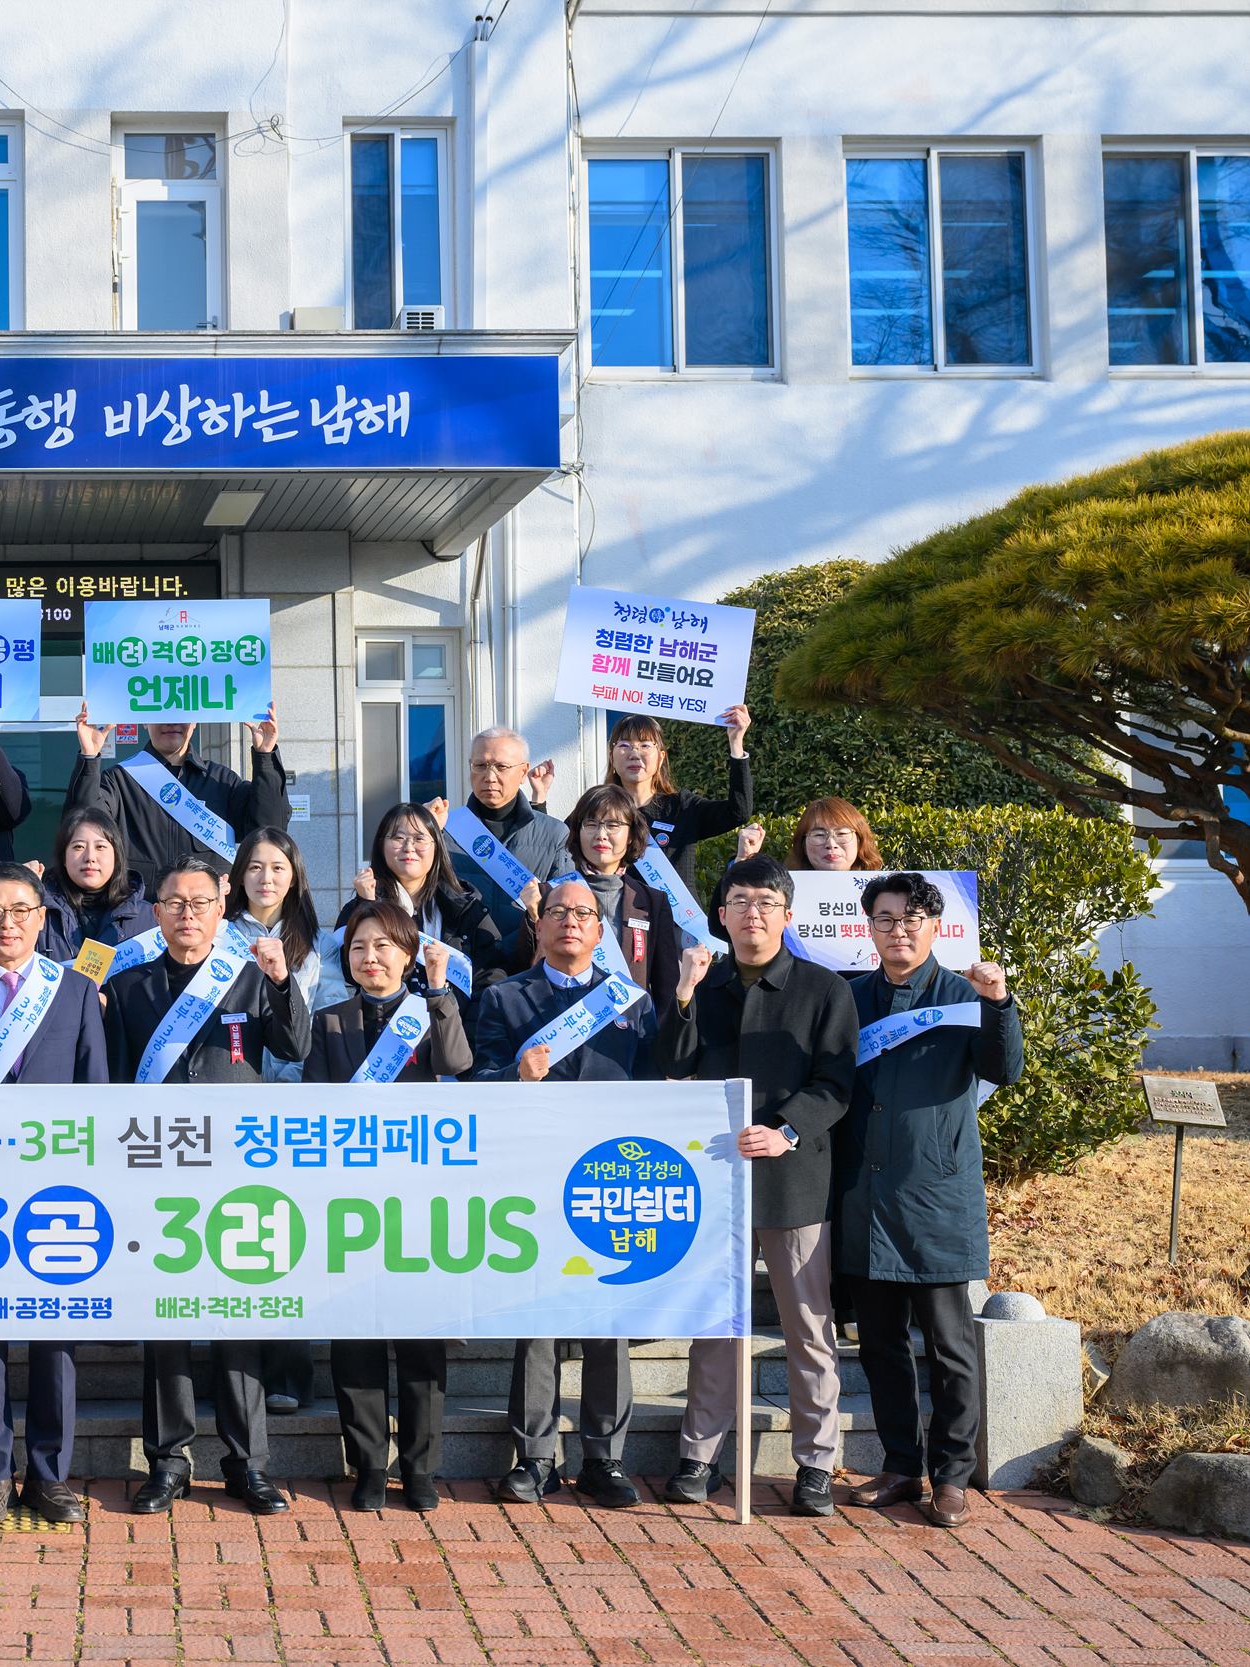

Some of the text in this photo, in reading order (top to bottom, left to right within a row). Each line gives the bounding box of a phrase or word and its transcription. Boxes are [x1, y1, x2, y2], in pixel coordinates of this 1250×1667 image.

[104, 384, 300, 446] 비상하는
[311, 384, 410, 445] 남해
[6, 576, 48, 598] 많은
[56, 575, 189, 598] 이용바랍니다.
[595, 628, 718, 663] 청렴한 남해군
[591, 653, 714, 688] 함께 만들어요
[127, 674, 238, 712] 언제나
[591, 684, 707, 713] 부패 NO! 청렴 YES!
[818, 902, 857, 916] 당신의
[798, 924, 837, 938] 당신의
[938, 924, 965, 938] 니다
[118, 1114, 214, 1169] 실천
[234, 1112, 479, 1169] 청렴캠페인
[582, 1160, 682, 1180] 자연과 감성의
[571, 1185, 695, 1223] 국민쉼터
[326, 1195, 539, 1275] PLUS
[609, 1227, 657, 1254] 남해
[154, 1295, 304, 1320] 배려·격려·장려
